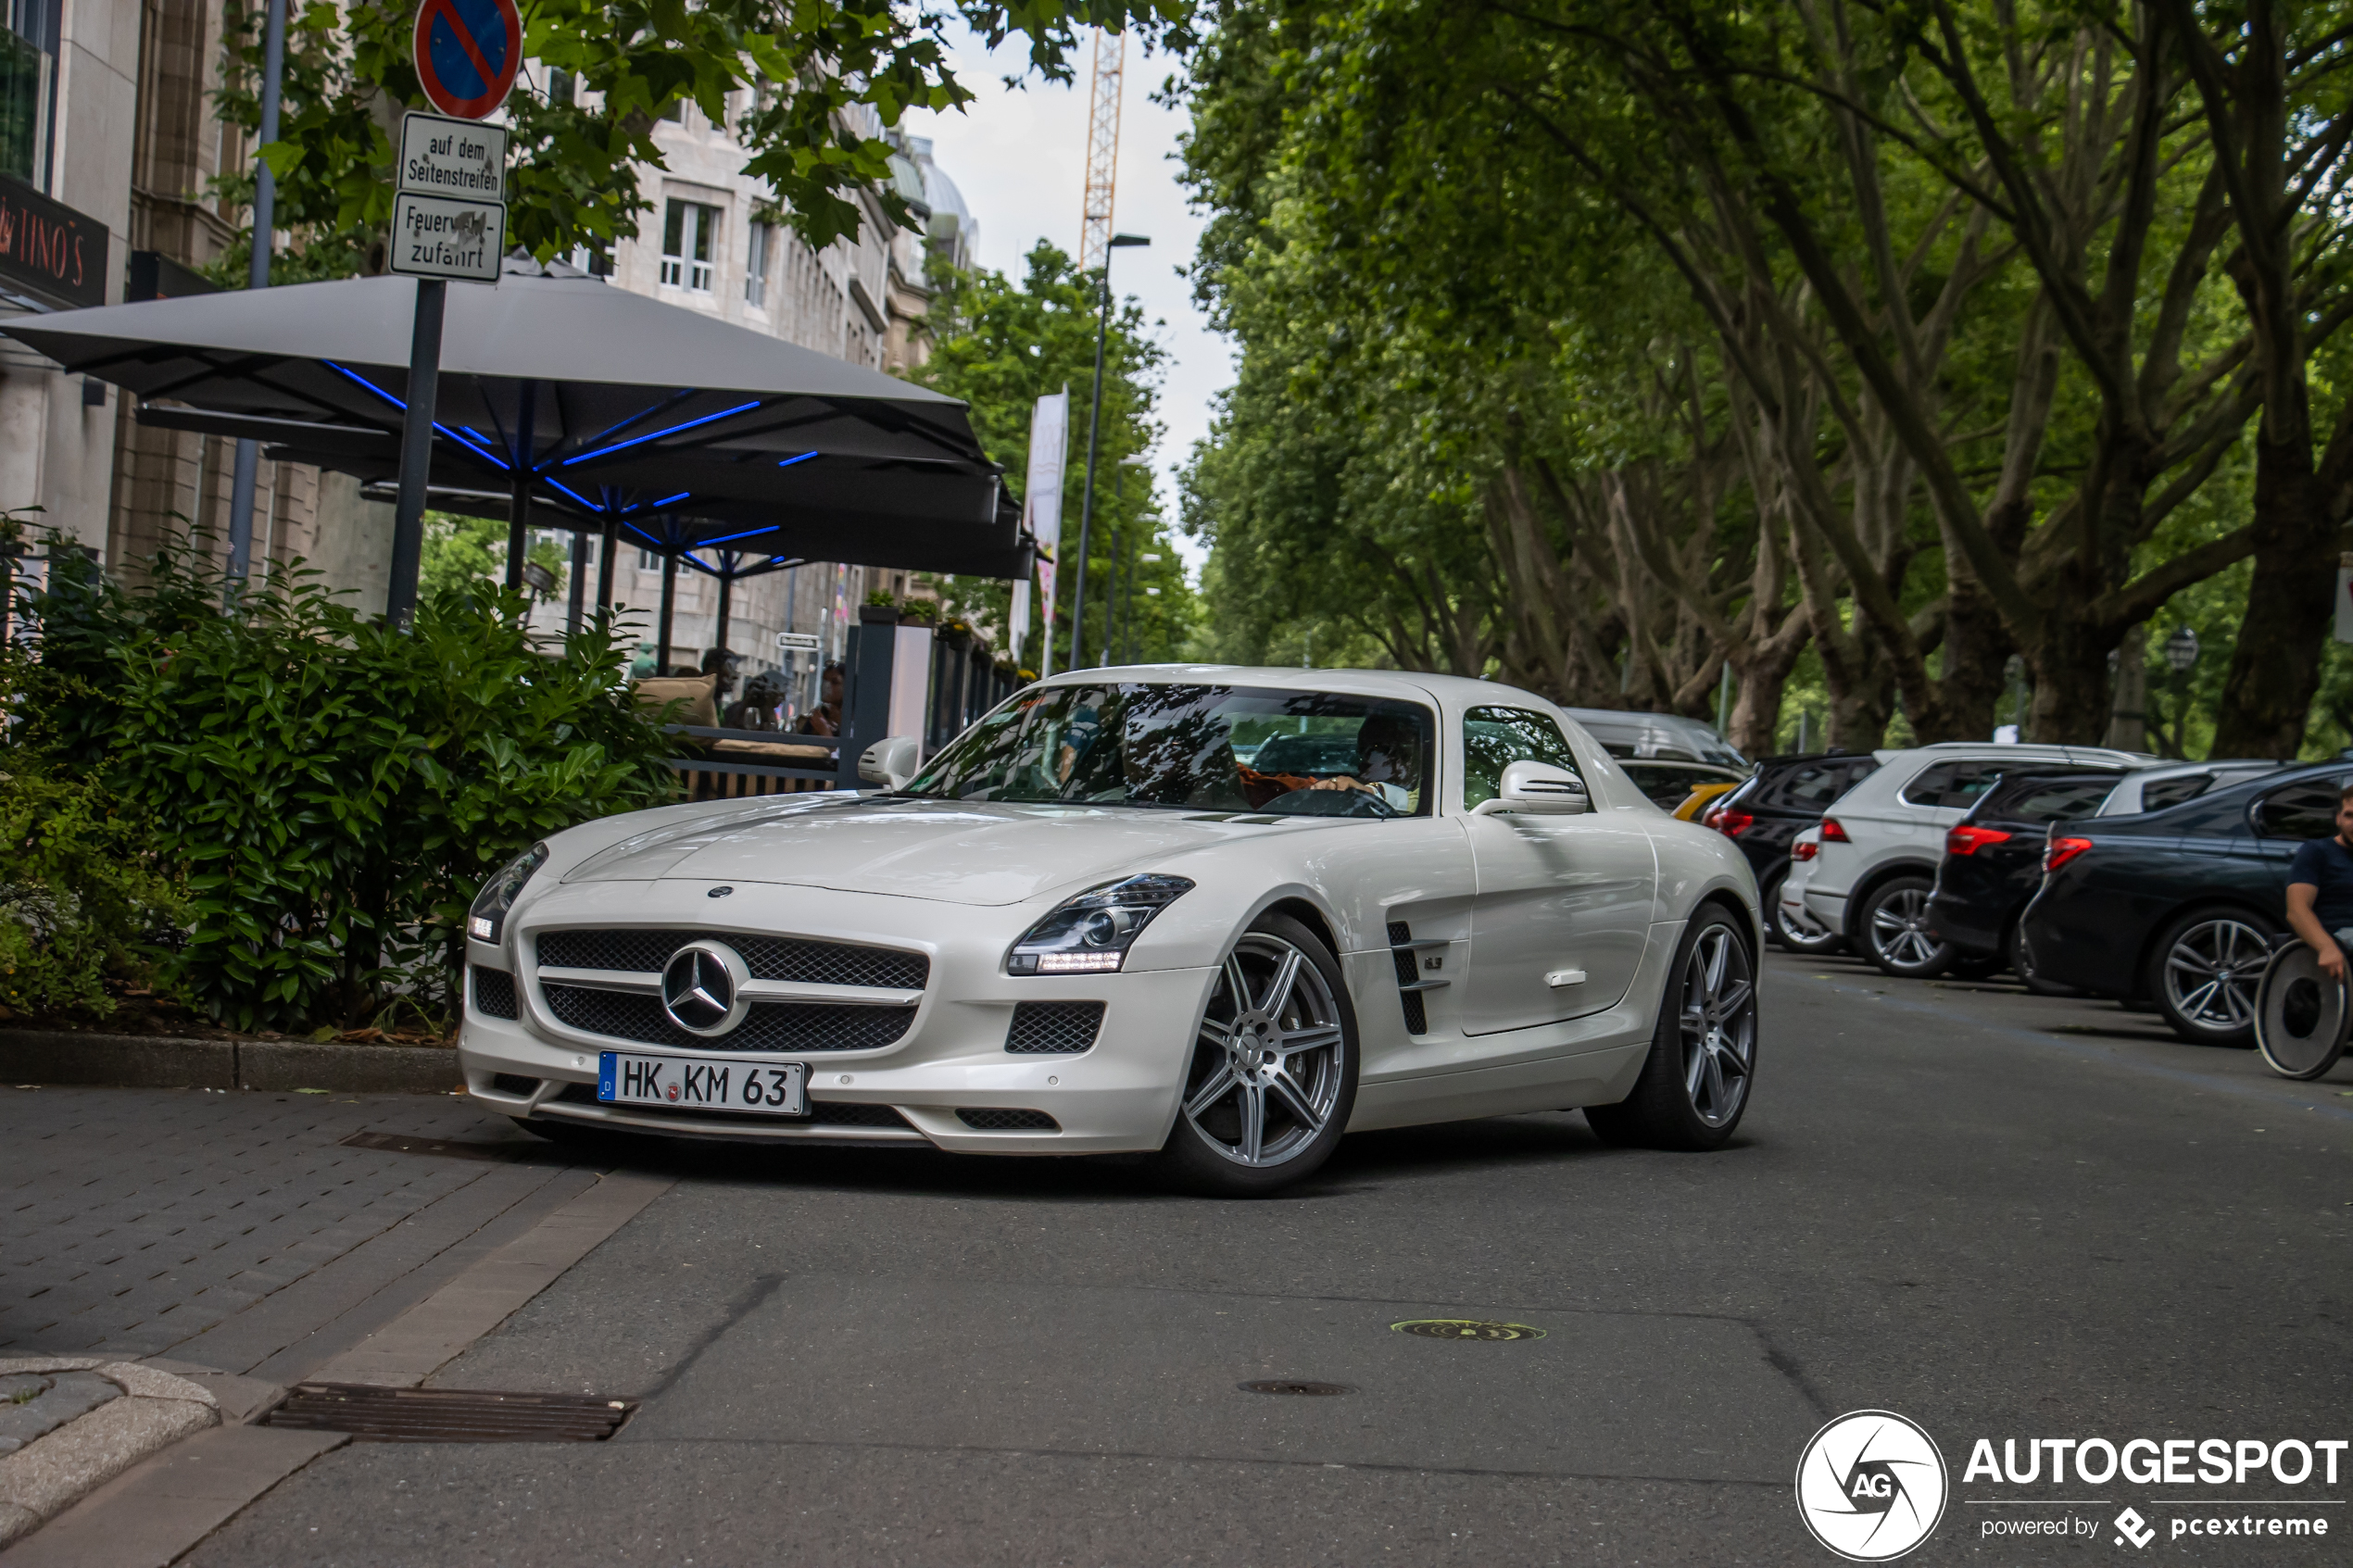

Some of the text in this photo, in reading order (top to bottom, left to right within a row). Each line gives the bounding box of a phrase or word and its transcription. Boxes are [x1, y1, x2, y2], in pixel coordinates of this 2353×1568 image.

[429, 135, 484, 160] auf dem
[409, 159, 497, 191] Seitenstreifen
[604, 1081, 611, 1092] D
[623, 1060, 788, 1106] HK KM 63
